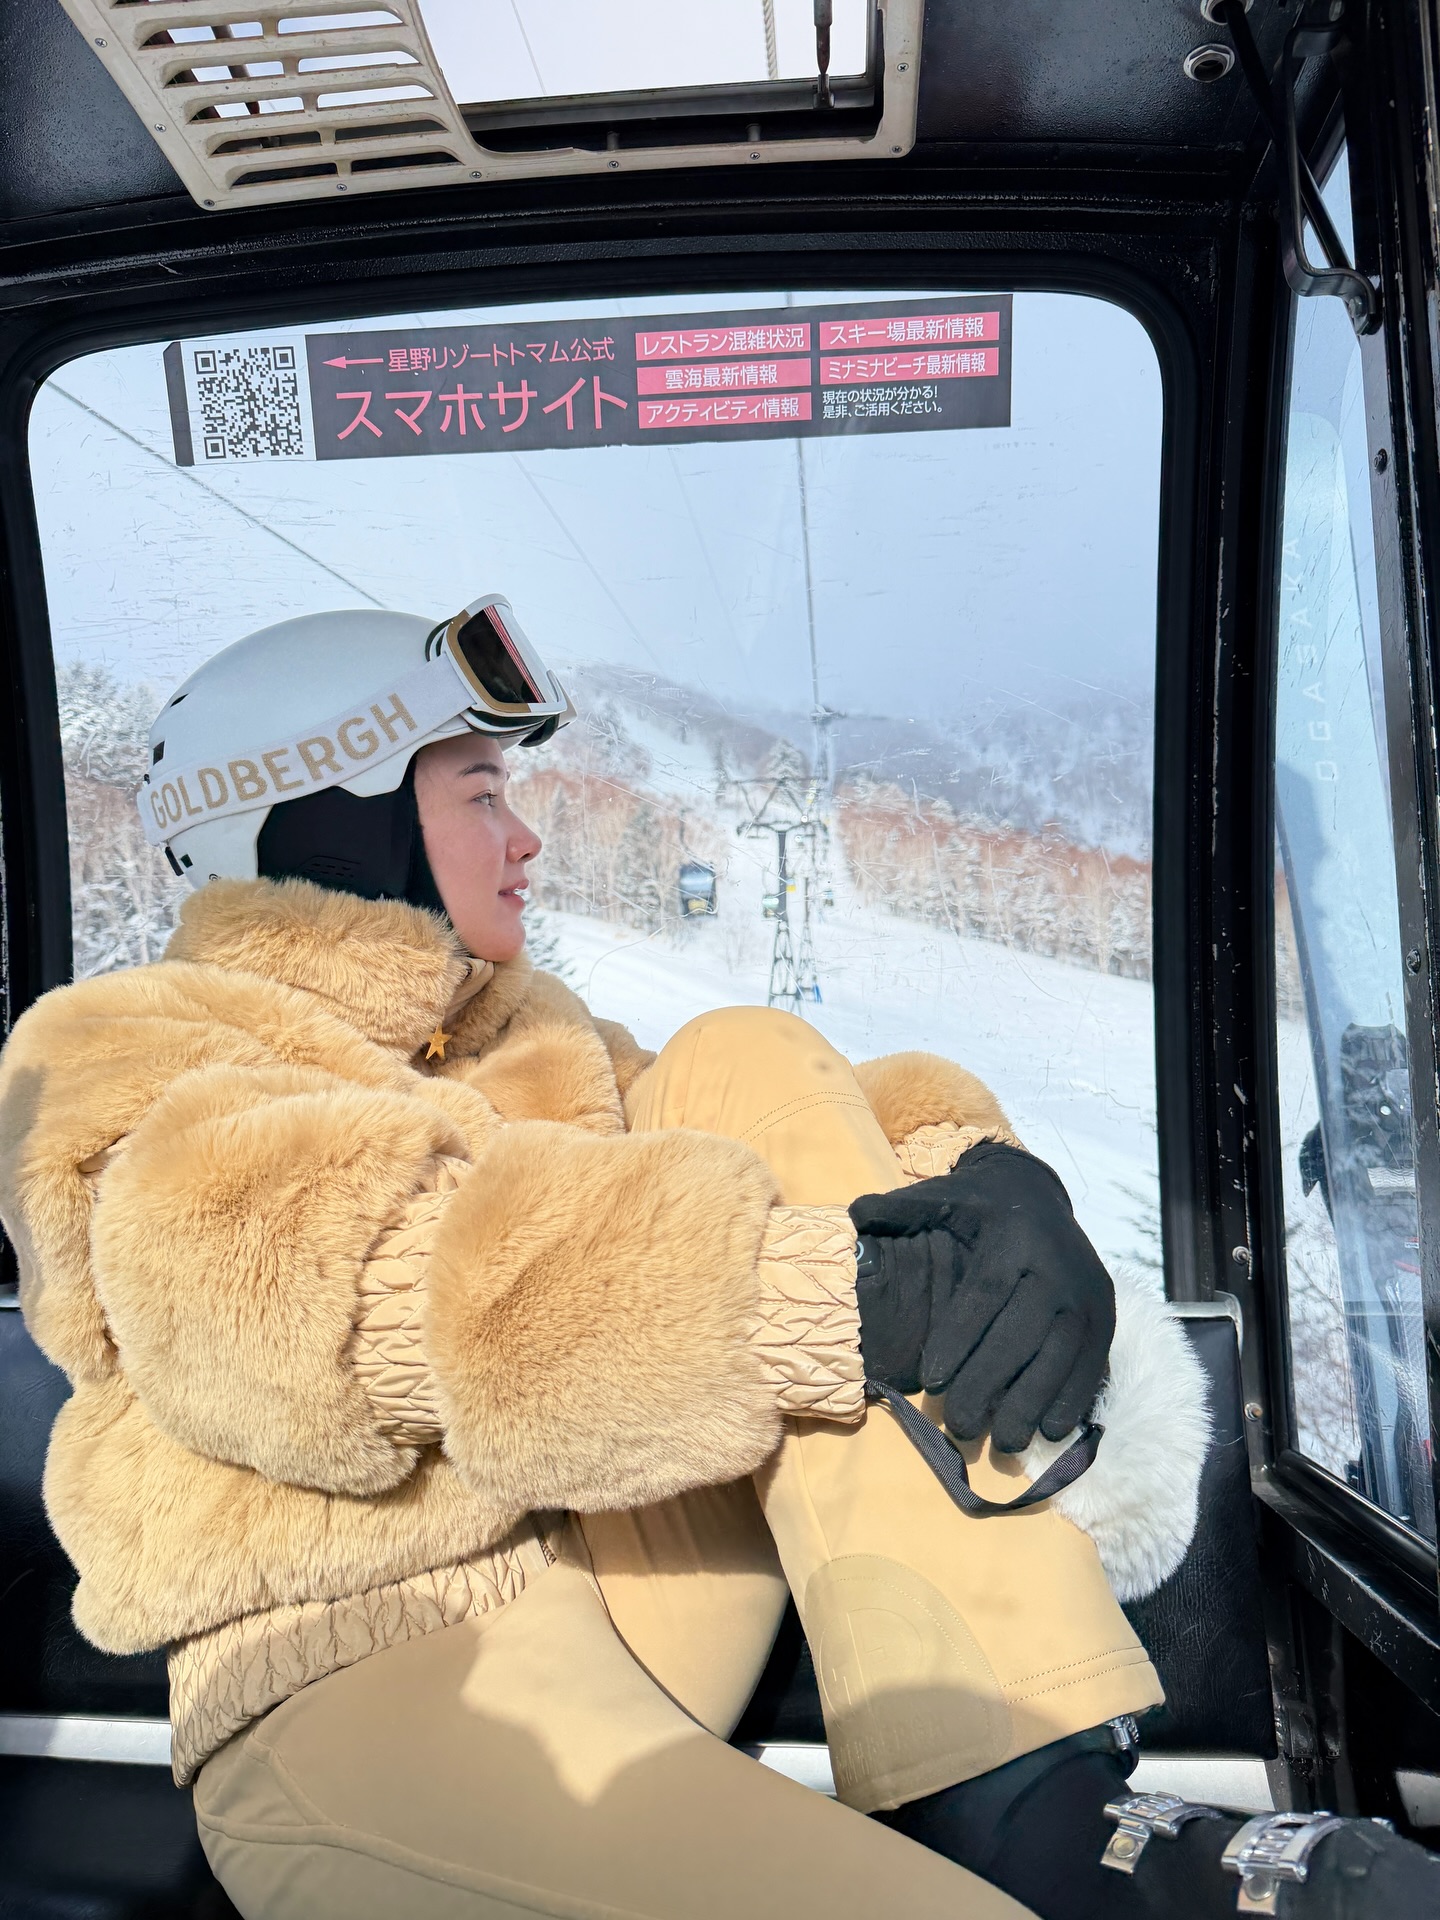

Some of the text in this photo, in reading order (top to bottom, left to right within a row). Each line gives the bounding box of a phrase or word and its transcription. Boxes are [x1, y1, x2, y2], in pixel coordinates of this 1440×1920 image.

[643, 327, 804, 356] レストラン混雑状況
[830, 316, 984, 345] スキー場最新情報
[388, 337, 615, 373] 星野リゾートトマム公式
[828, 352, 985, 380] ミナミナビーチ最新情報
[665, 364, 778, 390] 雲海最新情報
[336, 376, 628, 440] スマホサイト
[646, 397, 800, 424] アクティビティ情報
[149, 692, 418, 830] GOLDBERGH
